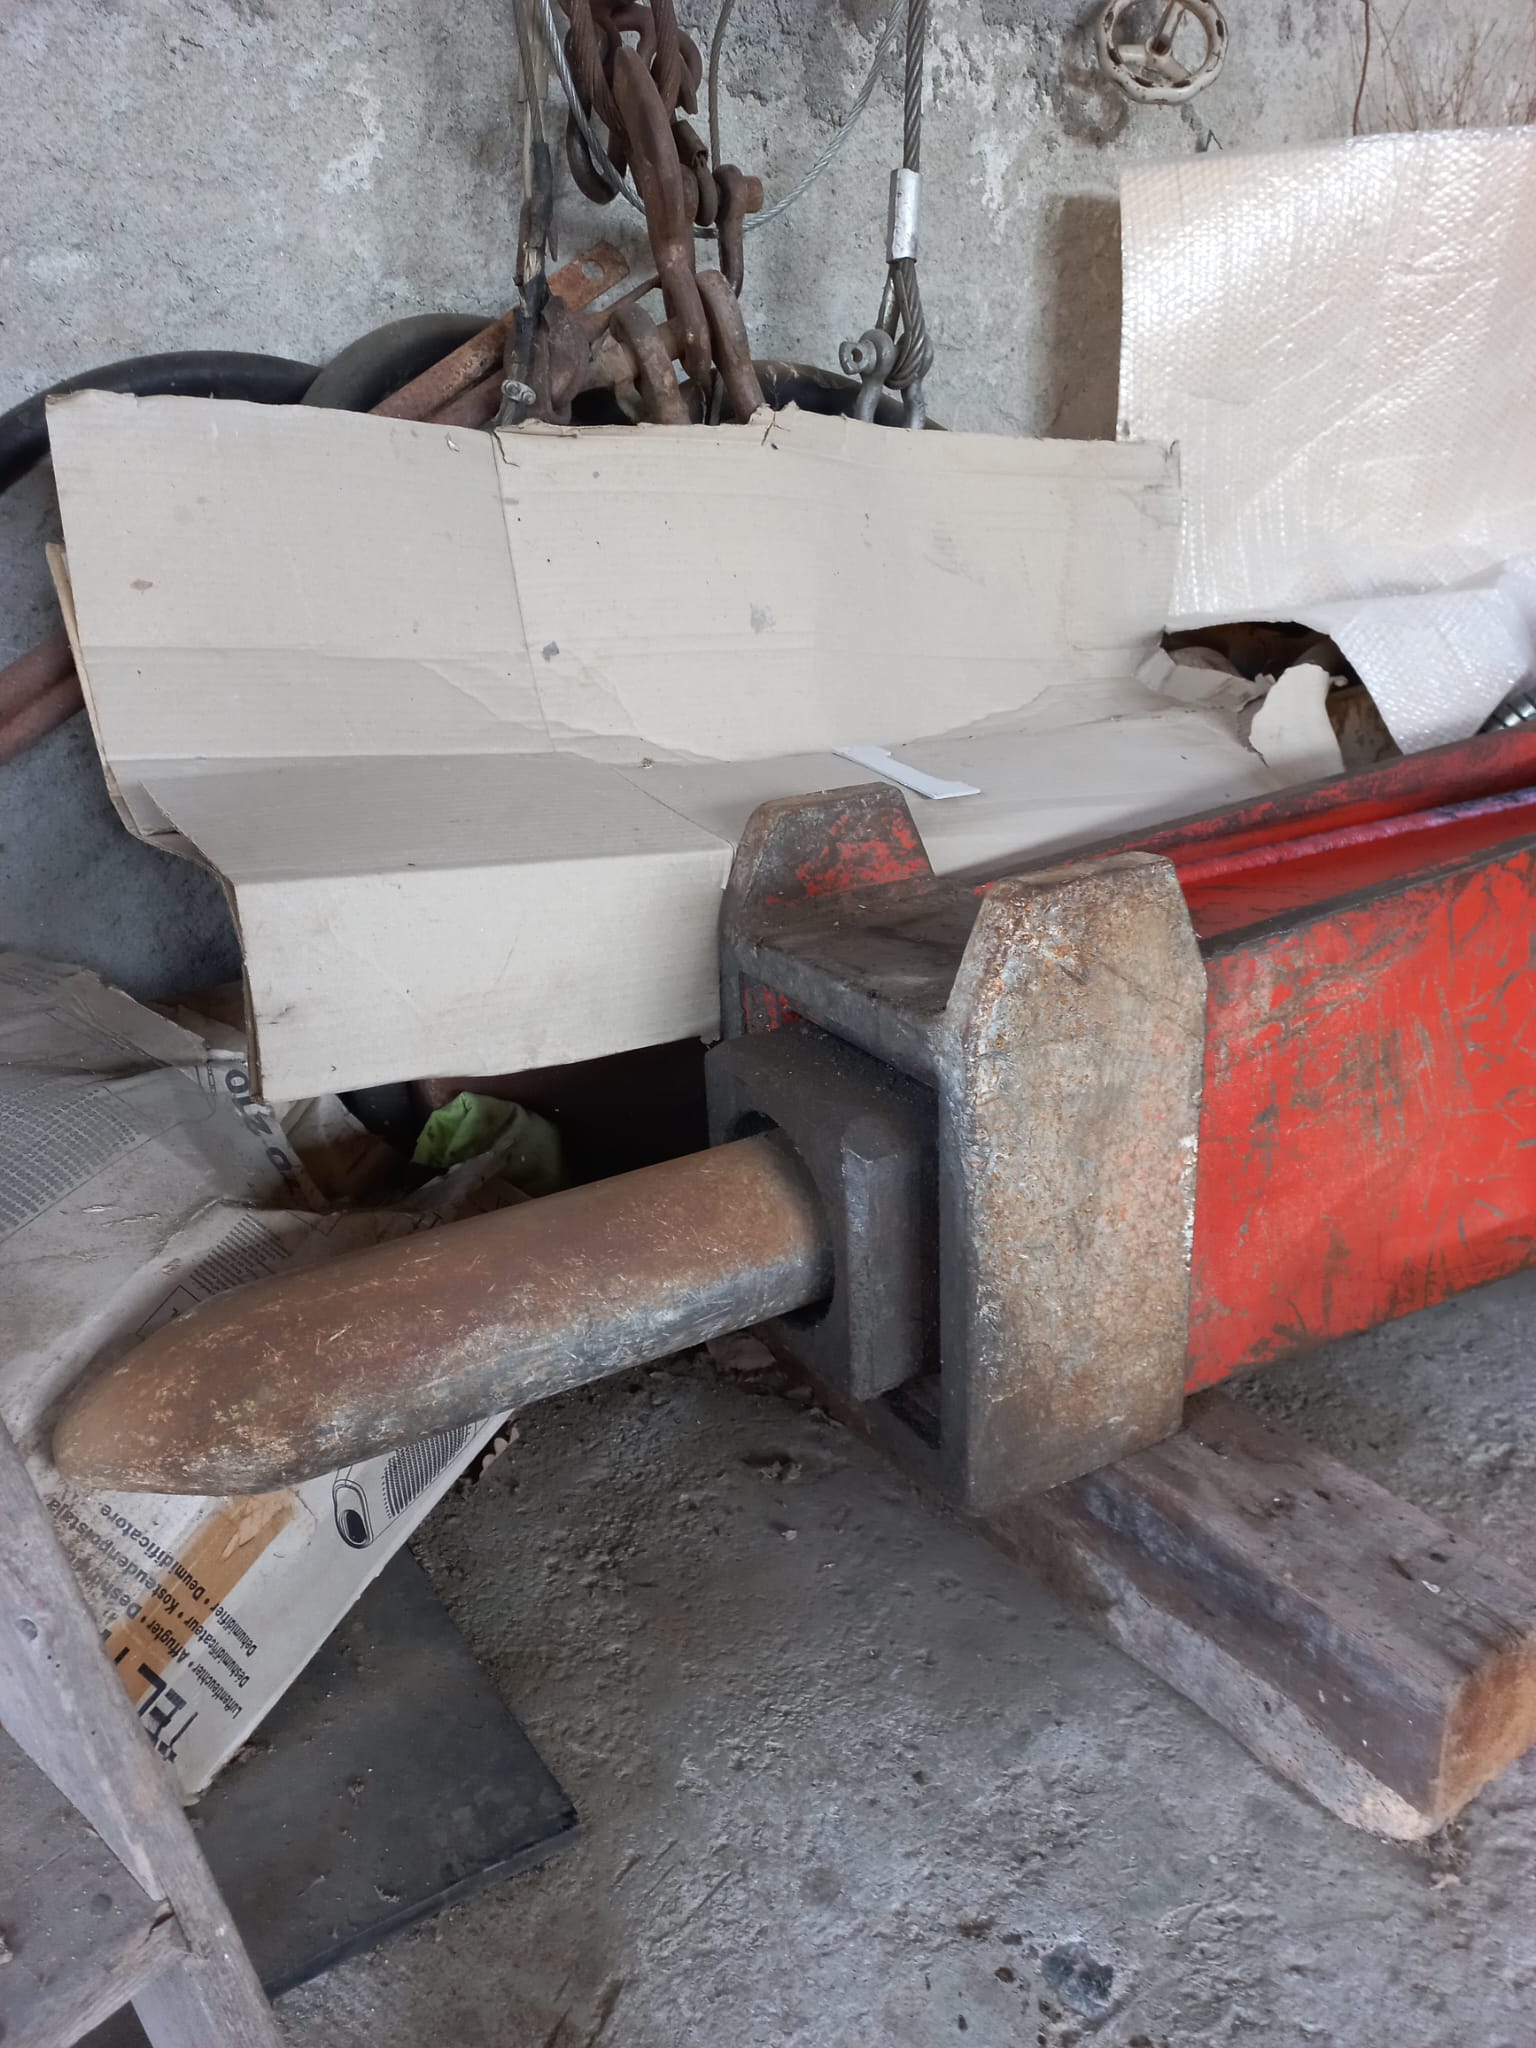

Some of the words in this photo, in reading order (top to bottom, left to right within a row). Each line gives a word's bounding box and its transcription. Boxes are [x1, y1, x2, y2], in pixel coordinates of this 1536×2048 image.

[100, 1503, 205, 1600] Deumidificatore
[146, 1619, 190, 1664] Affugter
[209, 1602, 257, 1657] Dehumidifier
[192, 1663, 243, 1719] Luftentfeuchter
